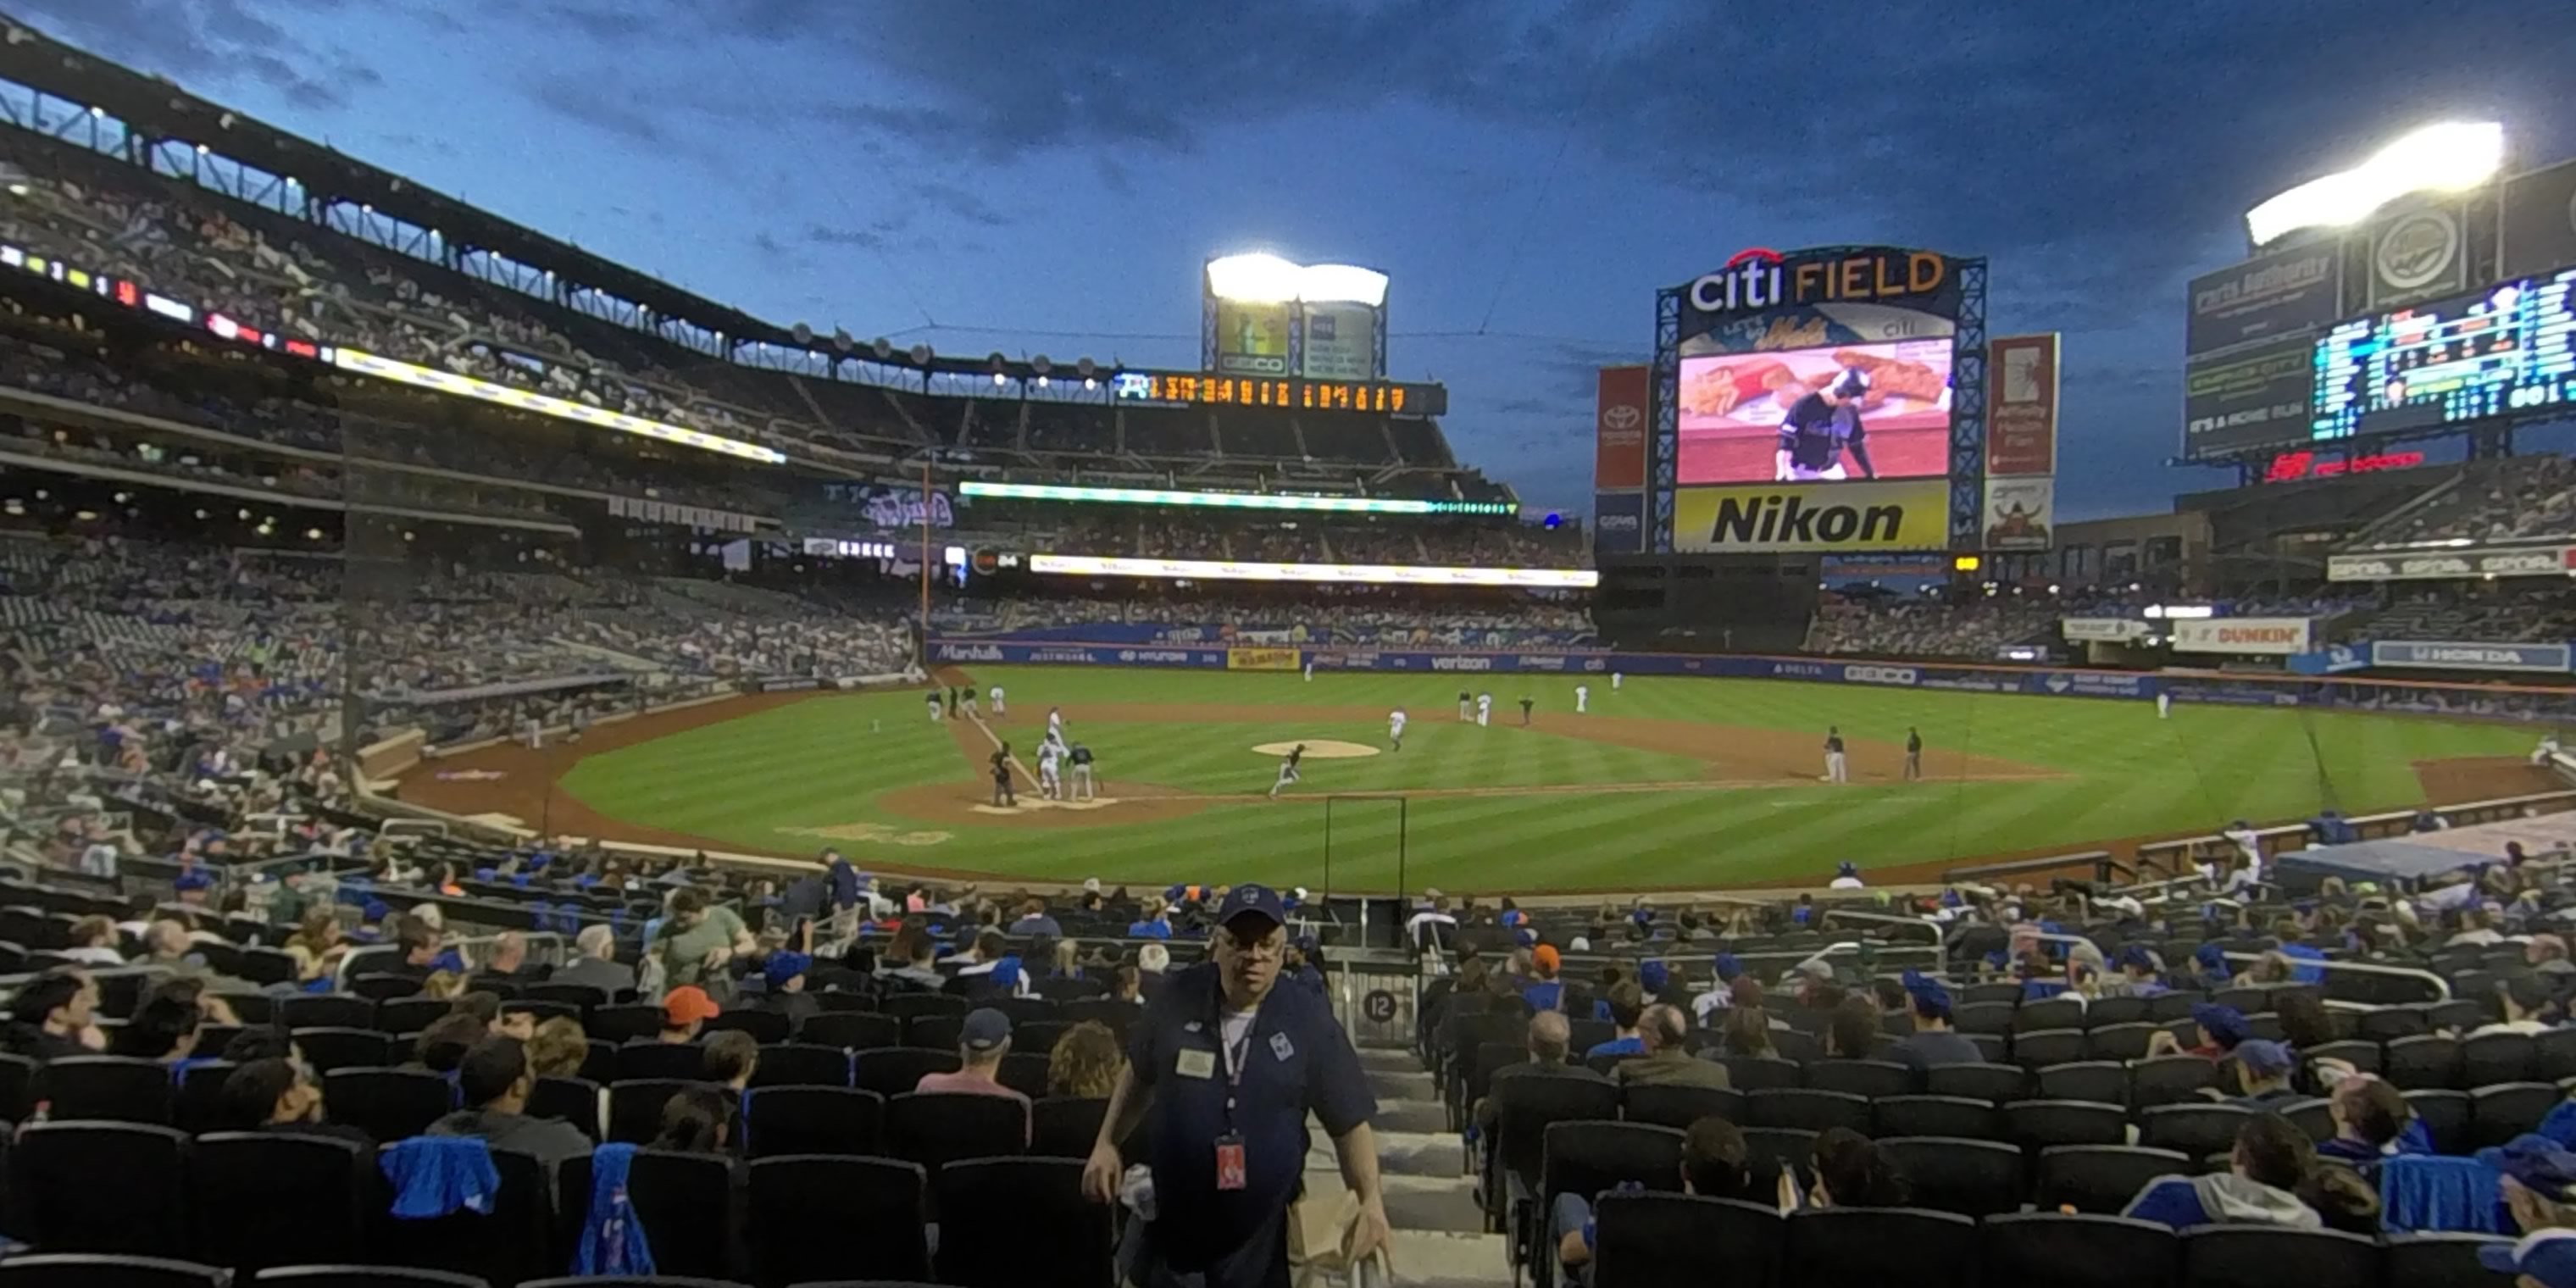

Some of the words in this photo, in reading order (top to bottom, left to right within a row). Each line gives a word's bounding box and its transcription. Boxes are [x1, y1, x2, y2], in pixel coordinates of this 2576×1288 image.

[1690, 259, 1781, 311] citi
[1796, 252, 1945, 301] FIELD
[1884, 319, 1916, 338] citi
[1710, 495, 1905, 542] Nikon
[936, 644, 1004, 660] Marshalls
[2431, 648, 2523, 663] HONDA
[1431, 654, 1491, 670] verizon
[1785, 663, 1822, 675] DELTA
[1845, 665, 1916, 684] GEICO
[1371, 996, 1390, 1016] 12
